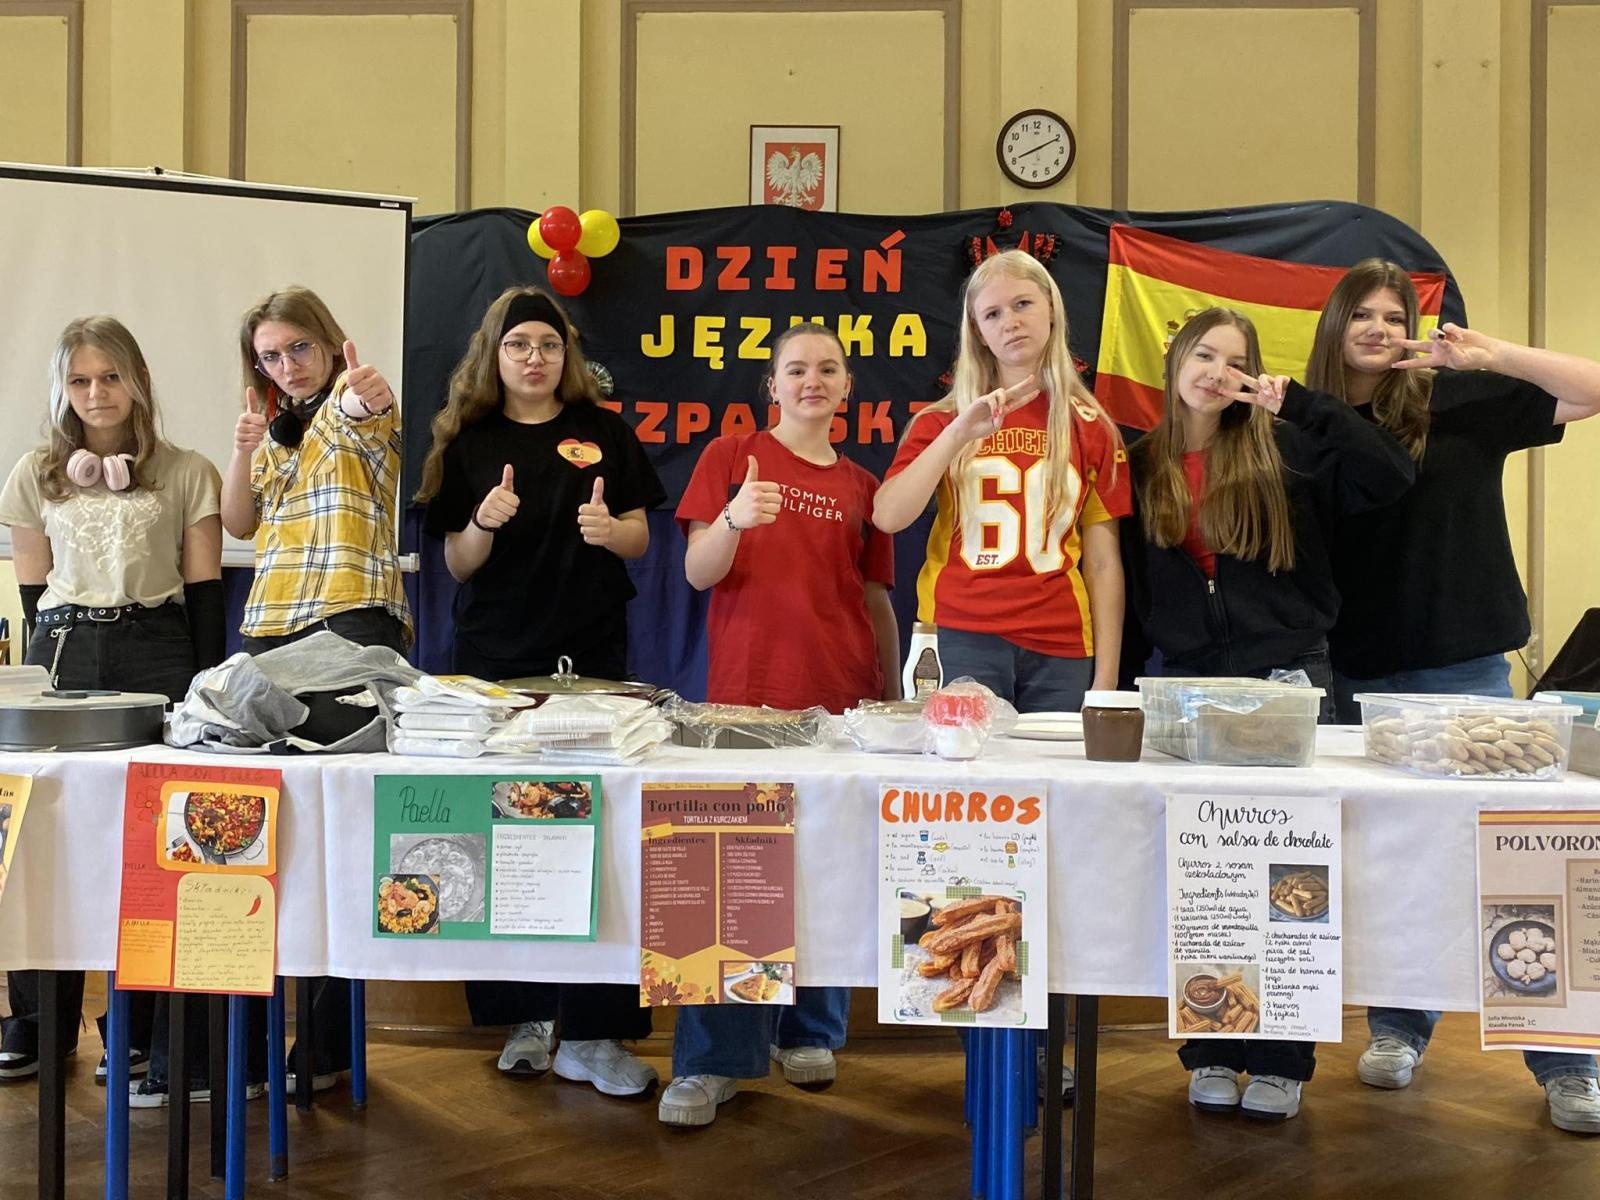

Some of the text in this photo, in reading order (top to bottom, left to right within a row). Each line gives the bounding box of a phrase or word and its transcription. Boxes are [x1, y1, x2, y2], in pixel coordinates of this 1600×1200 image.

[1021, 124, 1029, 132] 11
[1033, 121, 1041, 129] 12
[1011, 132, 1019, 141] 10
[1008, 145, 1013, 153] 9
[1059, 146, 1064, 154] 3
[1011, 157, 1017, 165] 8
[1053, 158, 1059, 166] 4
[1020, 166, 1025, 174] 7
[1032, 170, 1038, 178] 6
[1044, 167, 1050, 175] 5
[665, 230, 906, 293] DZIEŃ
[640, 313, 927, 370] JĘZKA
[598, 400, 948, 444] ZPASK
[780, 484, 837, 507] TOMMY
[784, 498, 843, 522] ILFIGER
[975, 554, 999, 566] EST.
[399, 786, 450, 823] Paella
[648, 799, 786, 815] Tortilla con pollo
[881, 789, 1041, 825] CHURROS
[683, 815, 748, 824] TORTILLA Z KURCZAKIEM
[1198, 800, 1293, 830] Churros
[1179, 830, 1334, 848] con salsa de chocolate
[1178, 857, 1212, 870] Churros
[1228, 906, 1248, 915] agua
[1300, 967, 1324, 975] harina
[1273, 1001, 1300, 1010] huevos
